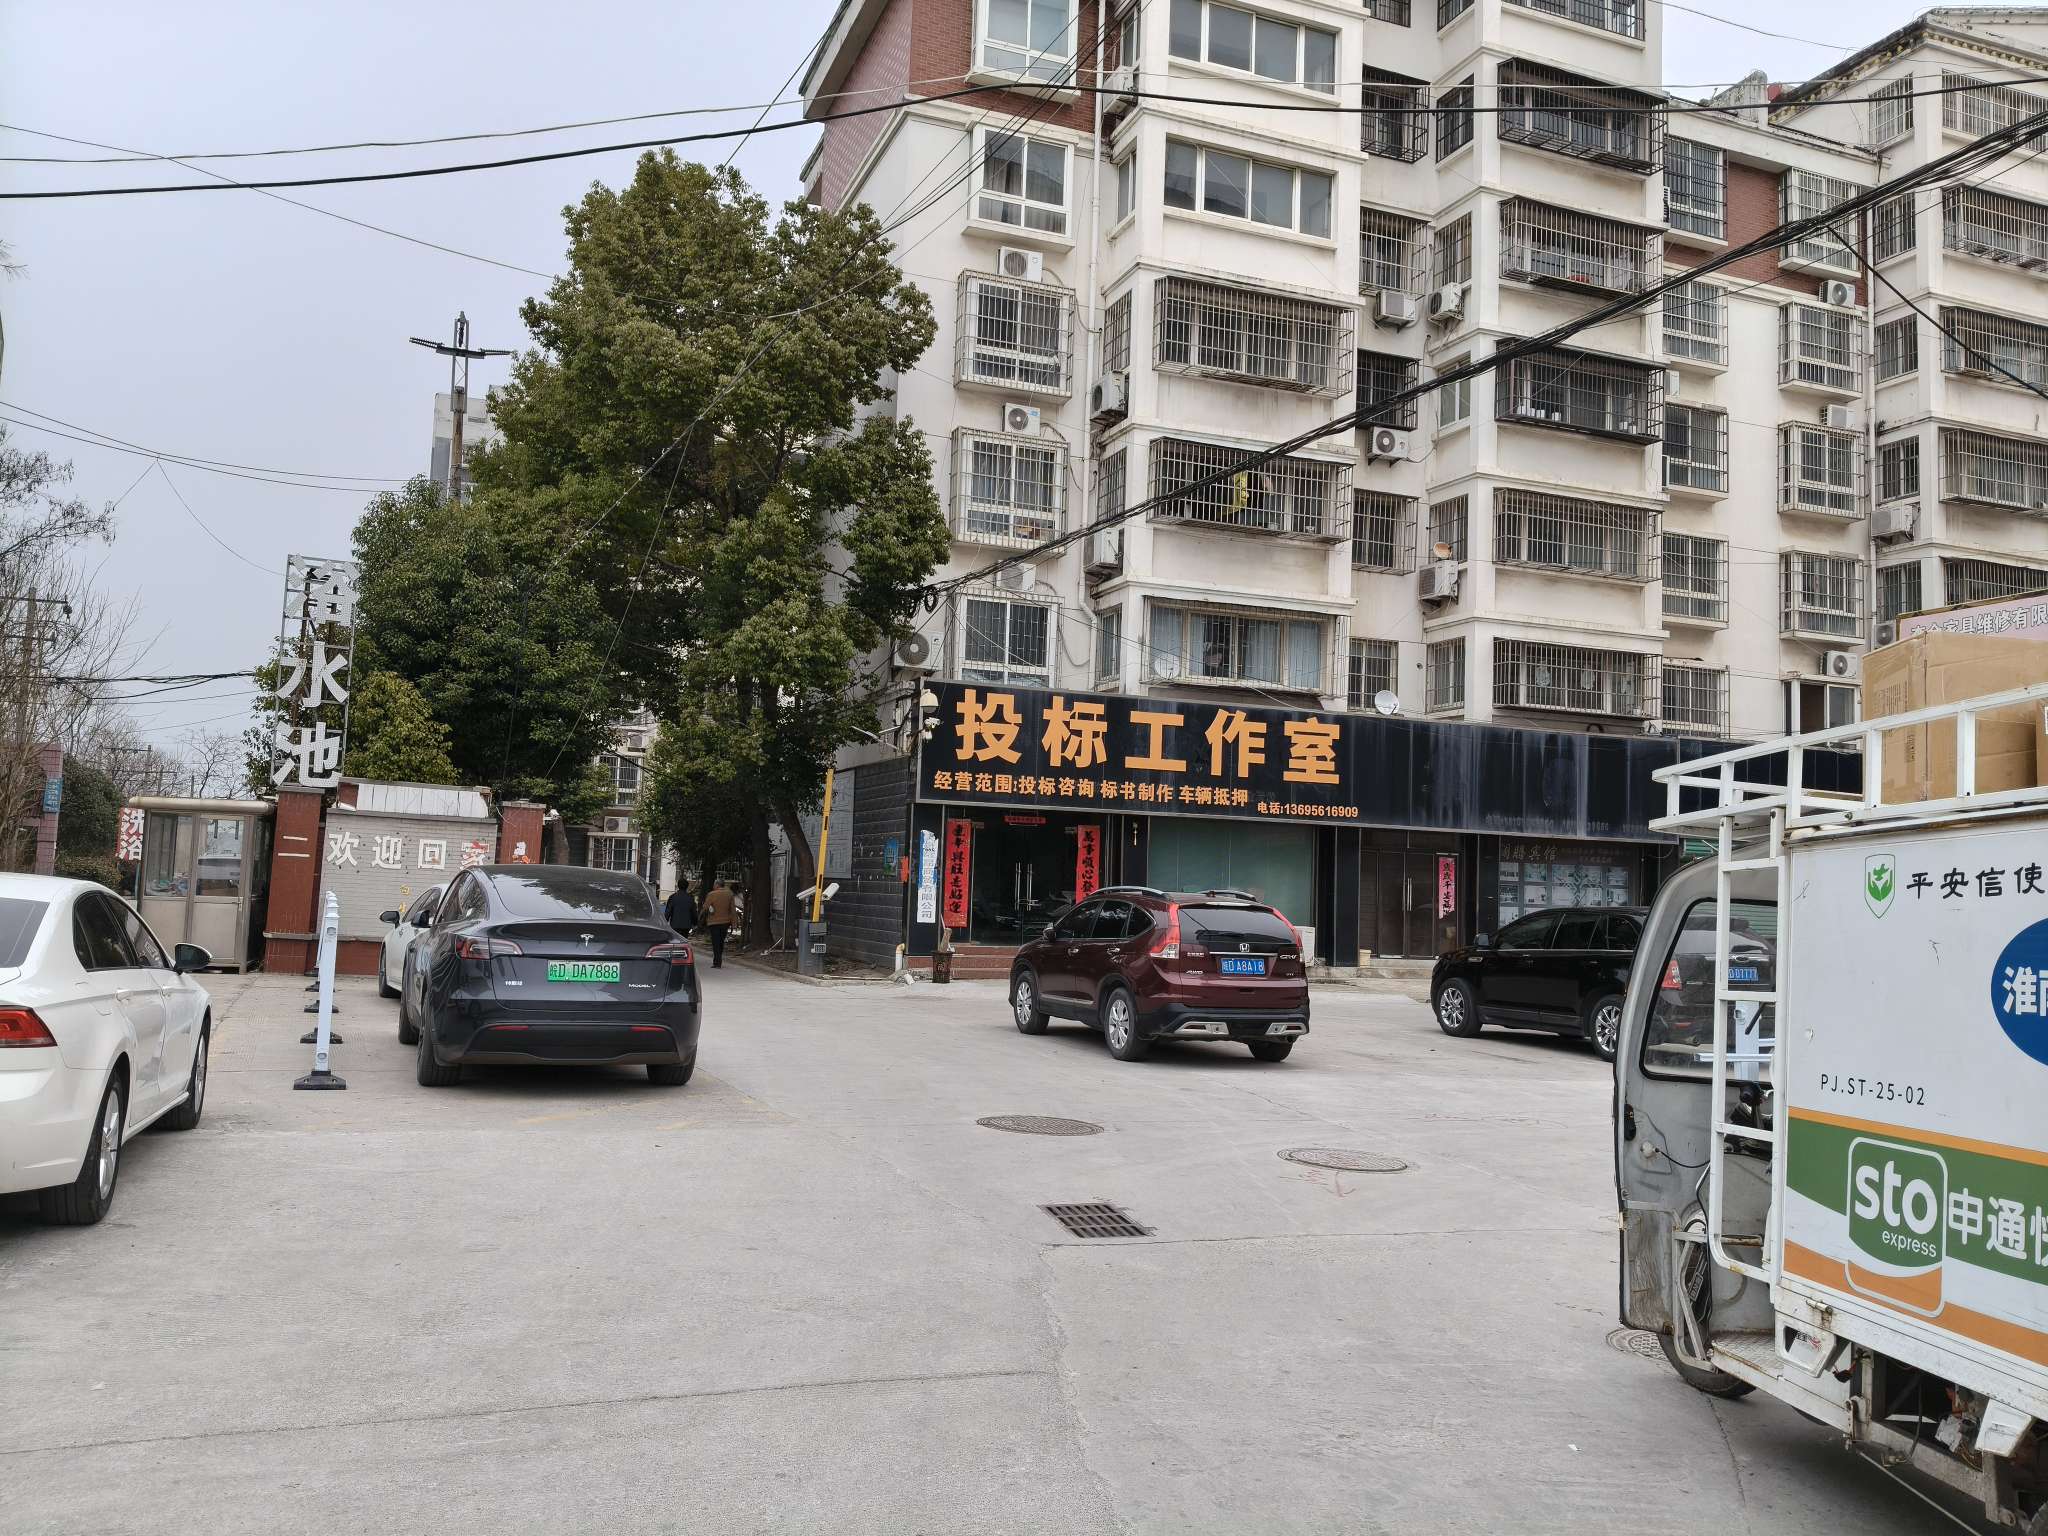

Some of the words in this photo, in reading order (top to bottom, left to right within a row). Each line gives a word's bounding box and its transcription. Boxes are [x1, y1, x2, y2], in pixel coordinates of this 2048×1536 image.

[955, 688, 1340, 785] 投标工作室
[1100, 780, 1174, 803] 标书制作
[1179, 785, 1249, 807] 车辆抵押
[1906, 862, 2046, 900] 平安信使
[2002, 966, 2048, 1017] 淮
[1820, 1073, 1925, 1106] PJ.ST-25-02
[1855, 1160, 1938, 1235] sto
[1882, 1229, 1937, 1258] express
